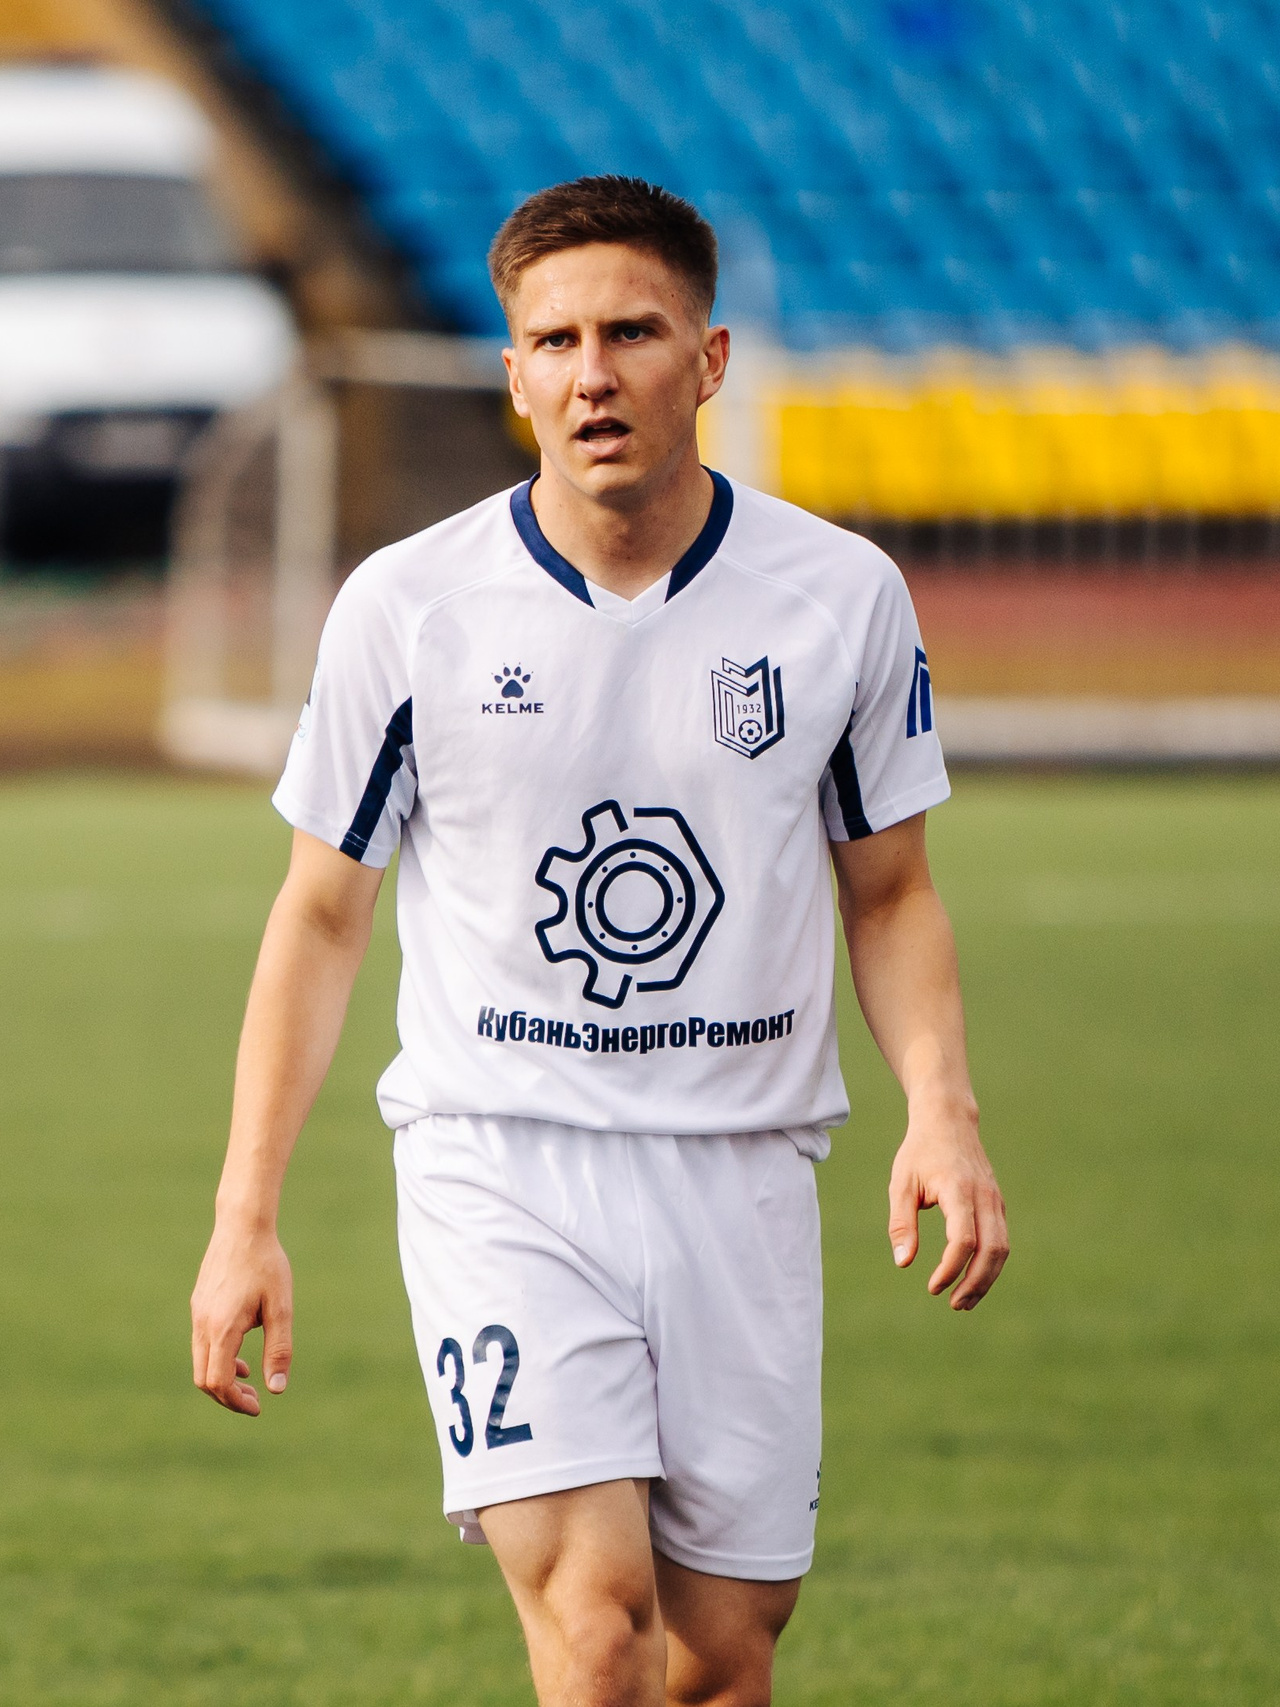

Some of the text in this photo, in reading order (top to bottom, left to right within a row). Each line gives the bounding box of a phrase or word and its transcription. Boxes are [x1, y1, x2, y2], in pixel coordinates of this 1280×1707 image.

[481, 702, 545, 714] KELME
[736, 704, 762, 714] 1932
[477, 1005, 795, 1054] КубаньЭнергоРемонт
[437, 1324, 533, 1458] 32
